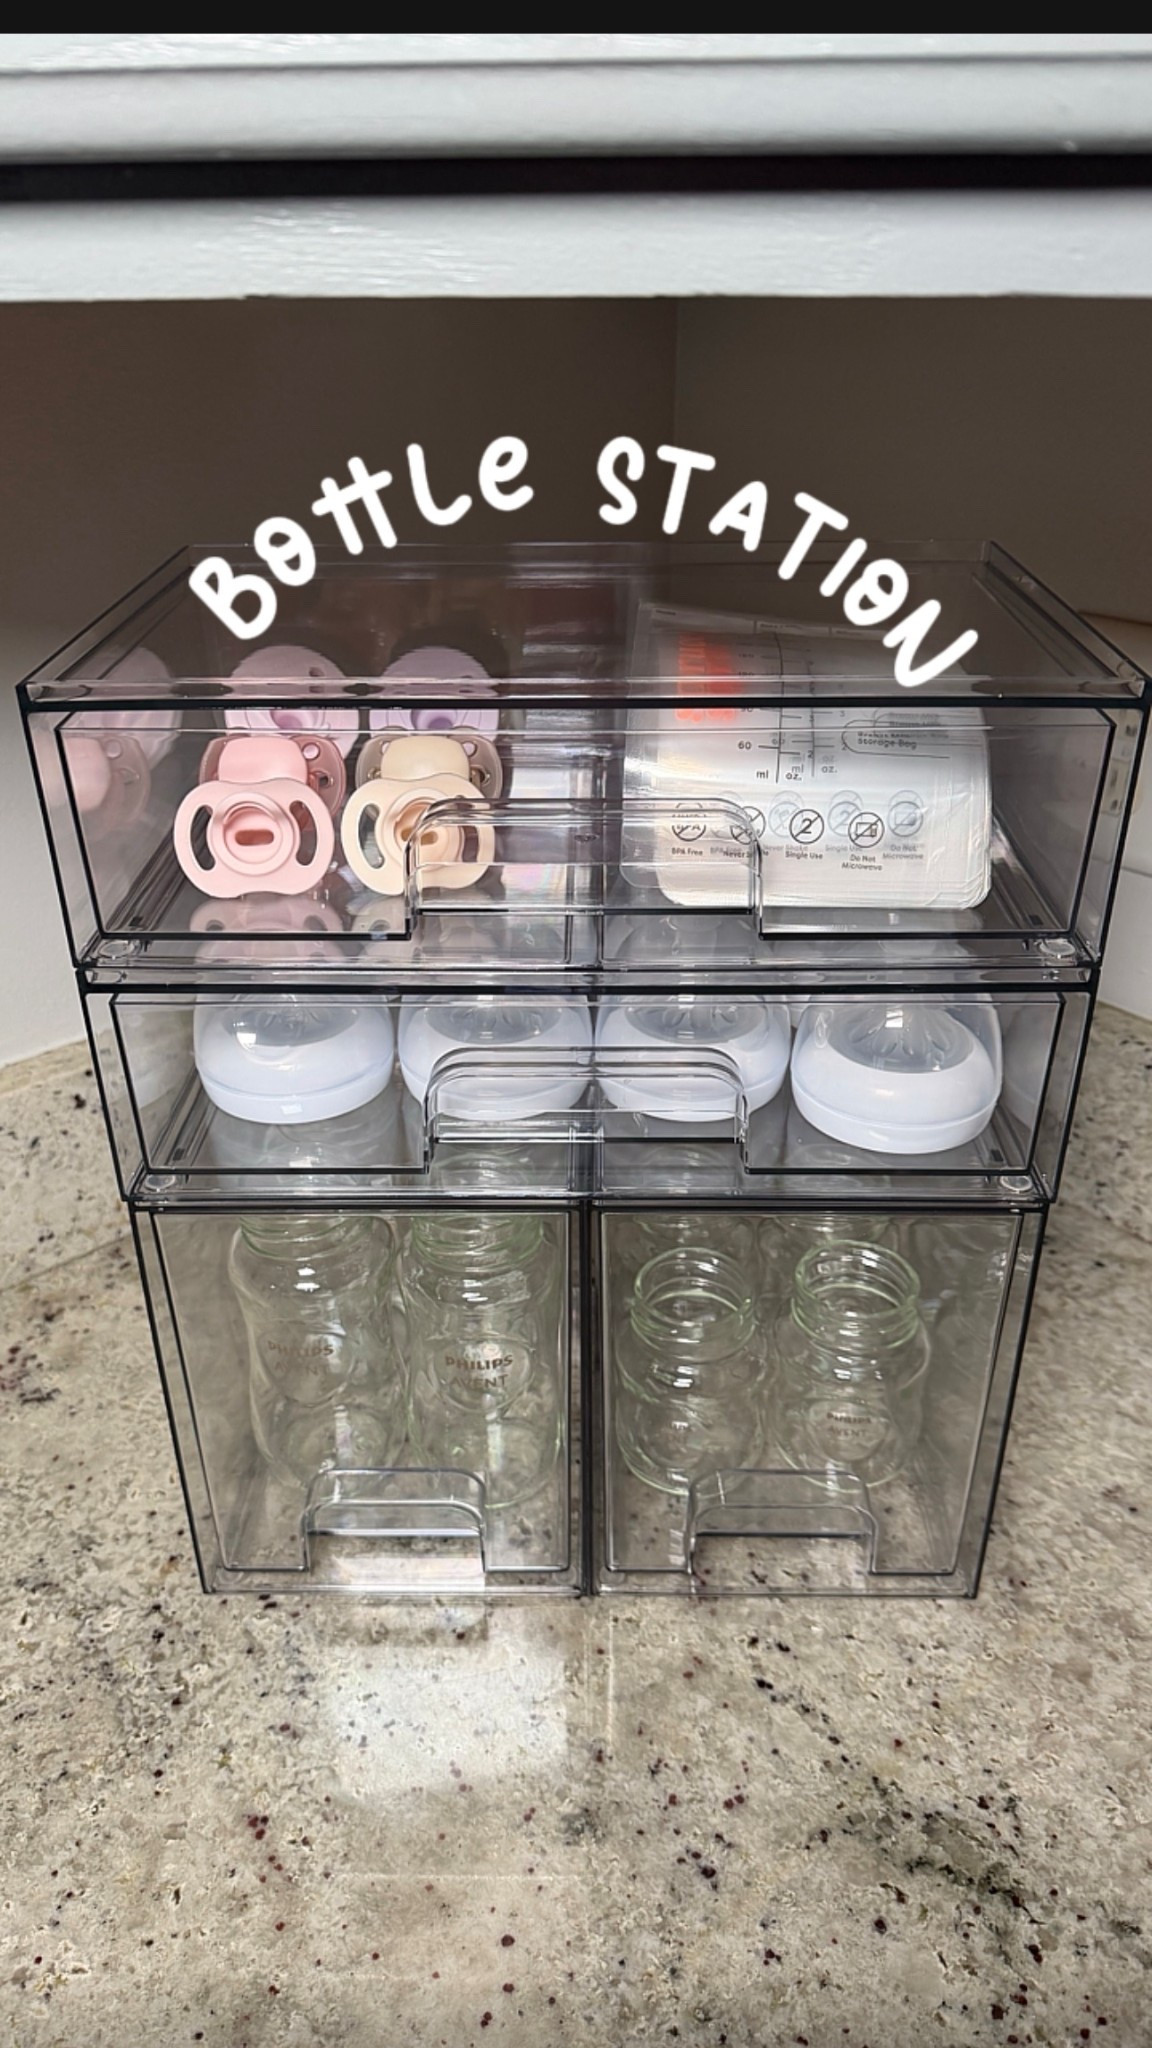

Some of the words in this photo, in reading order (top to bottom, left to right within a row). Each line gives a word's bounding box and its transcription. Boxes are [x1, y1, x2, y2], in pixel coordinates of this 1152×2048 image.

[738, 740, 752, 750] 60
[756, 769, 769, 779] ml
[785, 772, 802, 781] oz.
[671, 847, 686, 855] BPA
[687, 847, 703, 856] Free
[723, 849, 744, 858] Never
[785, 851, 808, 860] Single
[809, 852, 823, 860] Use
[850, 854, 861, 862] Do
[862, 854, 876, 863] Not
[842, 862, 882, 871] Microwave
[445, 1354, 514, 1371] PHILIPS
